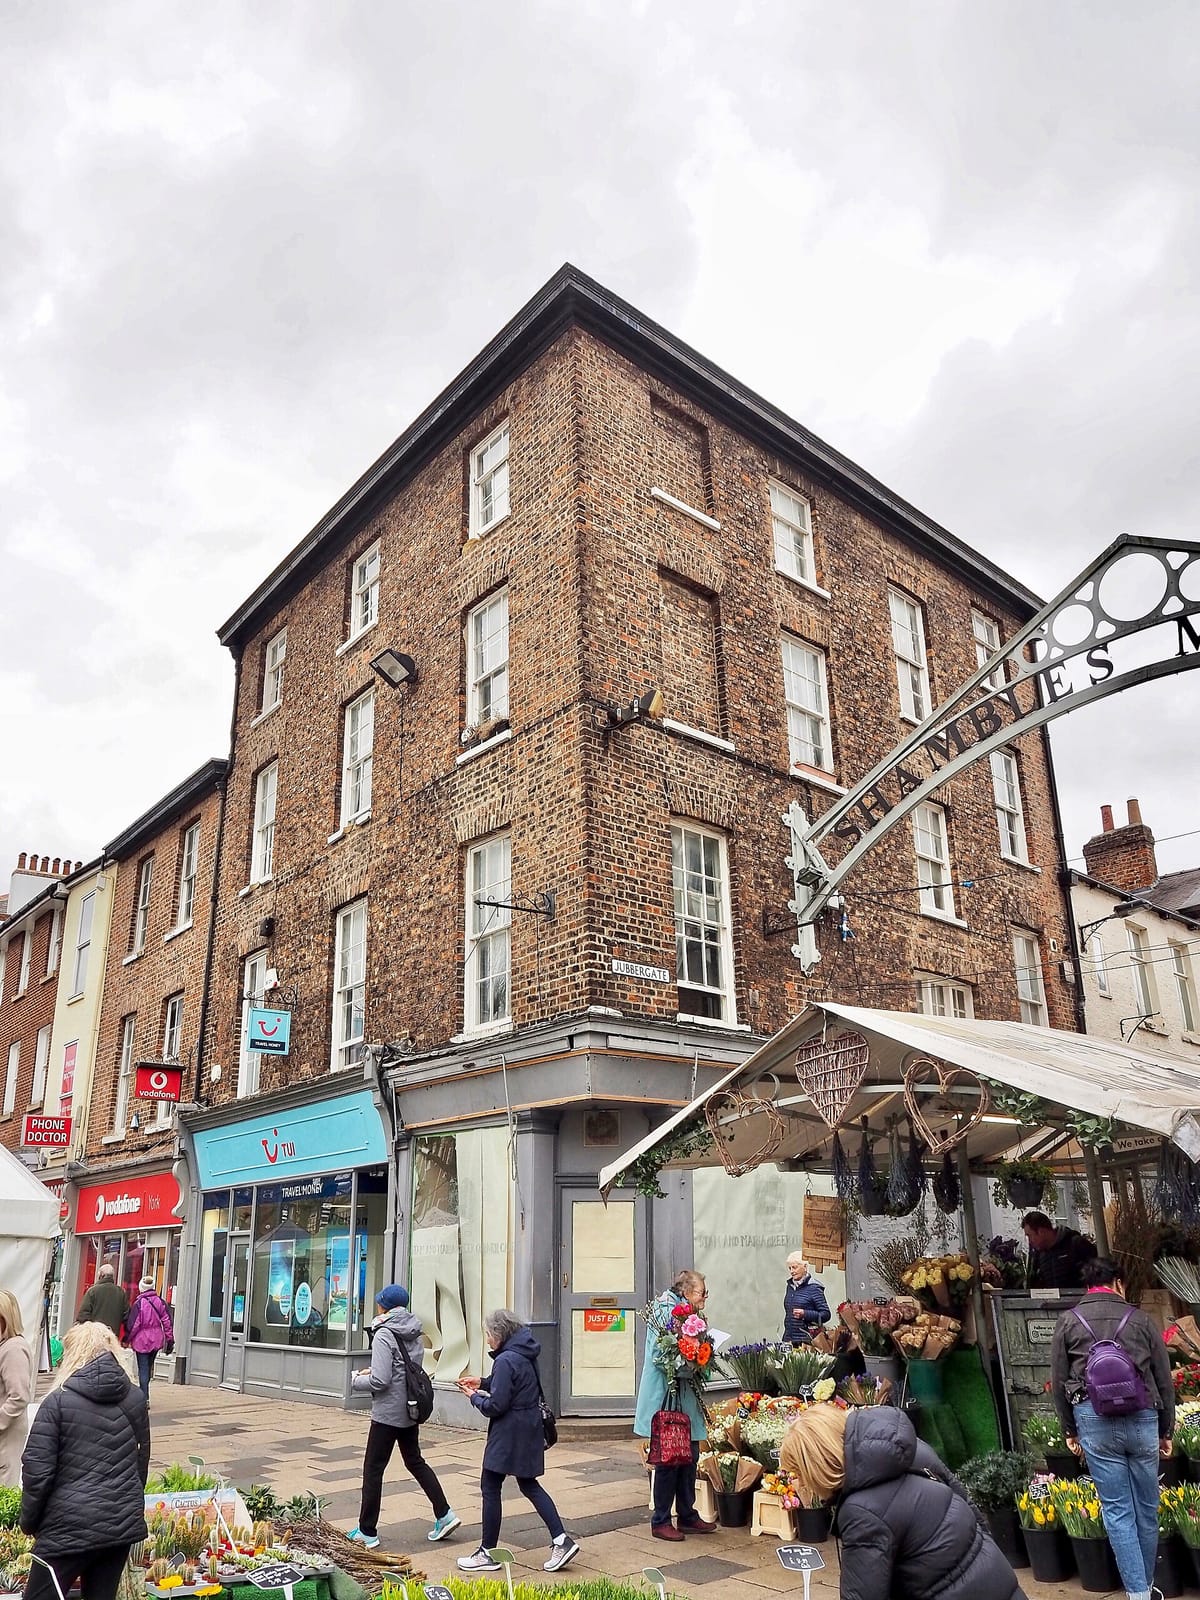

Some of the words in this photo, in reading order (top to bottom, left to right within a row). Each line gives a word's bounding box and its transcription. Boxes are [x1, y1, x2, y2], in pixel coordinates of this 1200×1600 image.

[832, 642, 1114, 842] SHAMBLES
[614, 961, 668, 981] JUBBERGATE
[139, 1089, 176, 1099] vodafone
[31, 1119, 65, 1130] PHONE
[27, 1131, 67, 1143] DOCTOR
[281, 1141, 296, 1158] TUI
[1117, 1140, 1132, 1150] We
[1135, 1137, 1154, 1147] take
[282, 1187, 302, 1199] TRAVEL
[105, 1193, 141, 1216] vodafone
[148, 1194, 160, 1211] York
[588, 1315, 606, 1323] JUST
[174, 1499, 198, 1508] CACTUS
